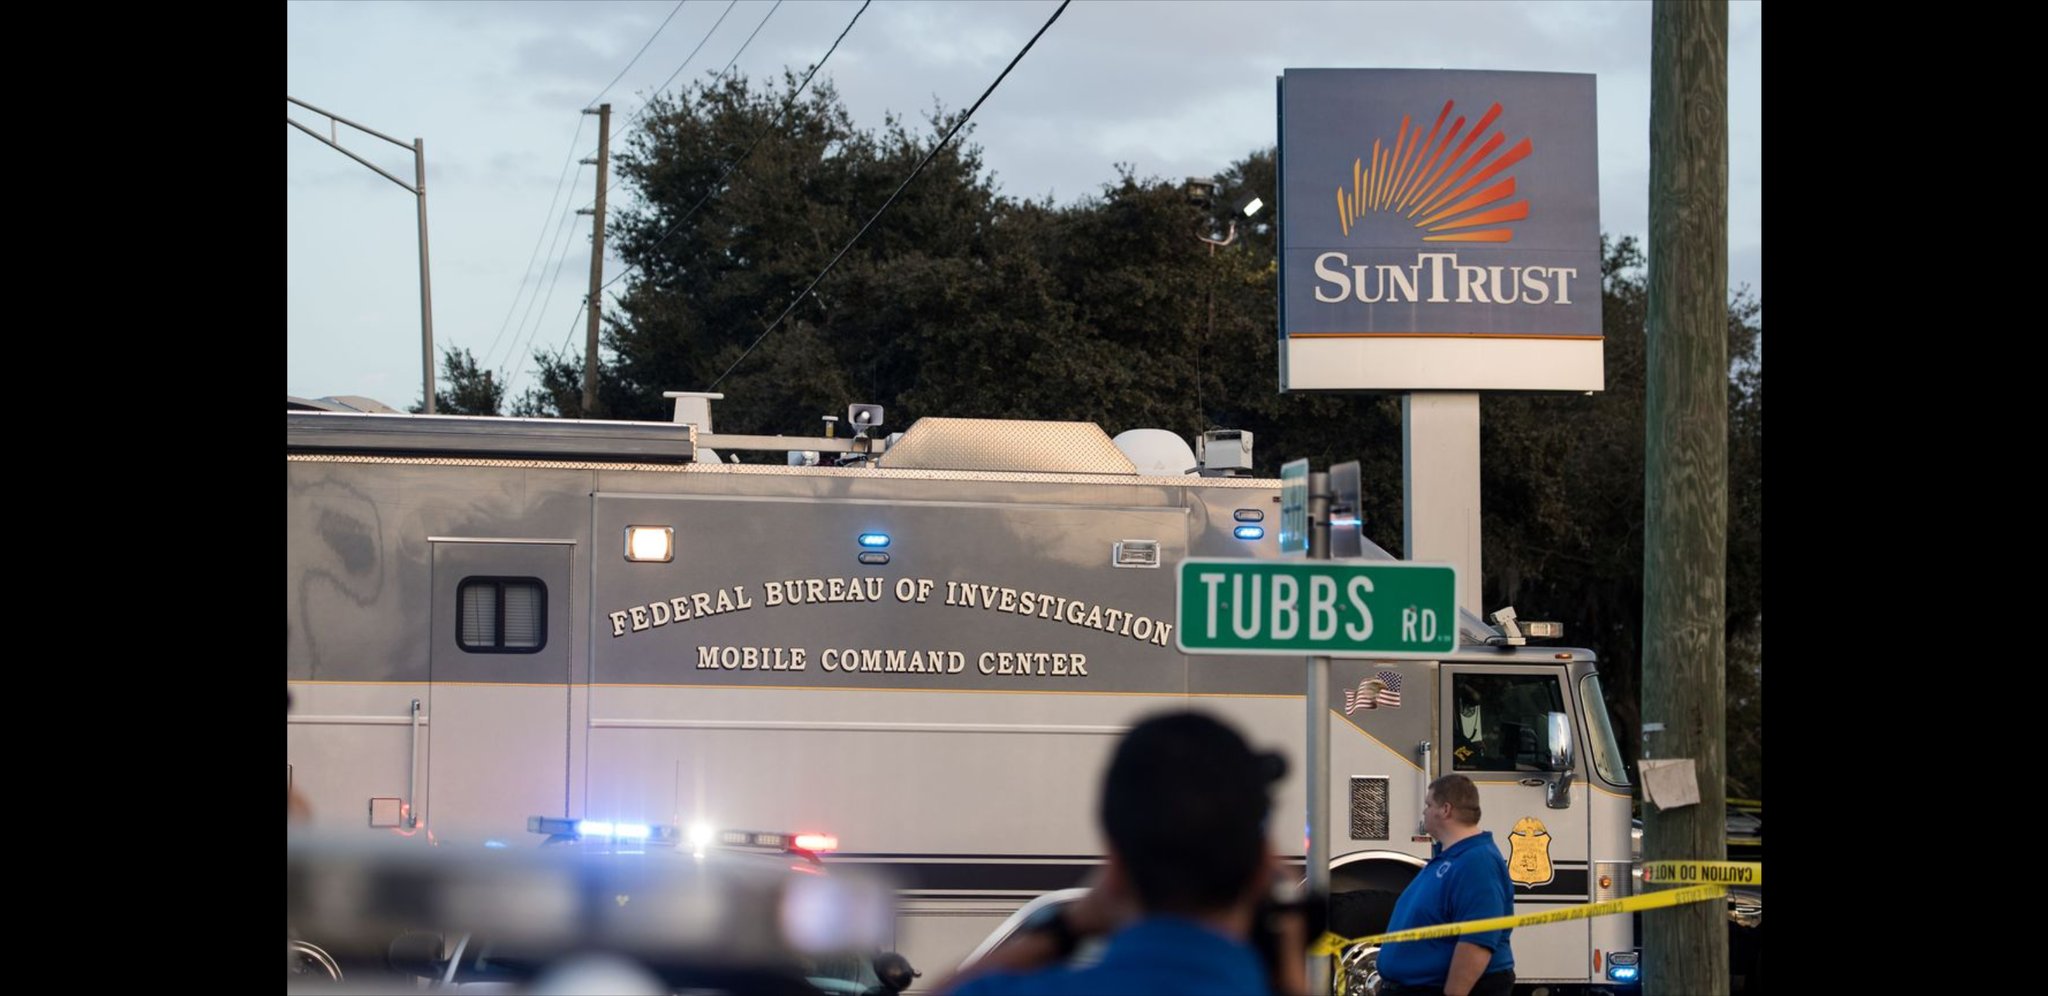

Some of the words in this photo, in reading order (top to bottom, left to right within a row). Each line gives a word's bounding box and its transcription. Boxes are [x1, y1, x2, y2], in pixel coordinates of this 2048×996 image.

[608, 585, 752, 637] FEDERAL
[763, 576, 885, 607] BUREAU
[894, 577, 935, 603] OF
[944, 580, 1173, 648] INVESTIGATION
[1200, 572, 1375, 642] TUBBS
[1401, 608, 1438, 643] RD
[696, 645, 807, 671] MOBILE
[820, 648, 966, 674] COMMAND
[977, 651, 1089, 677] CENTER
[1656, 864, 1676, 880] NOT
[1680, 864, 1697, 881] DO
[1701, 864, 1753, 882] CAUTION
